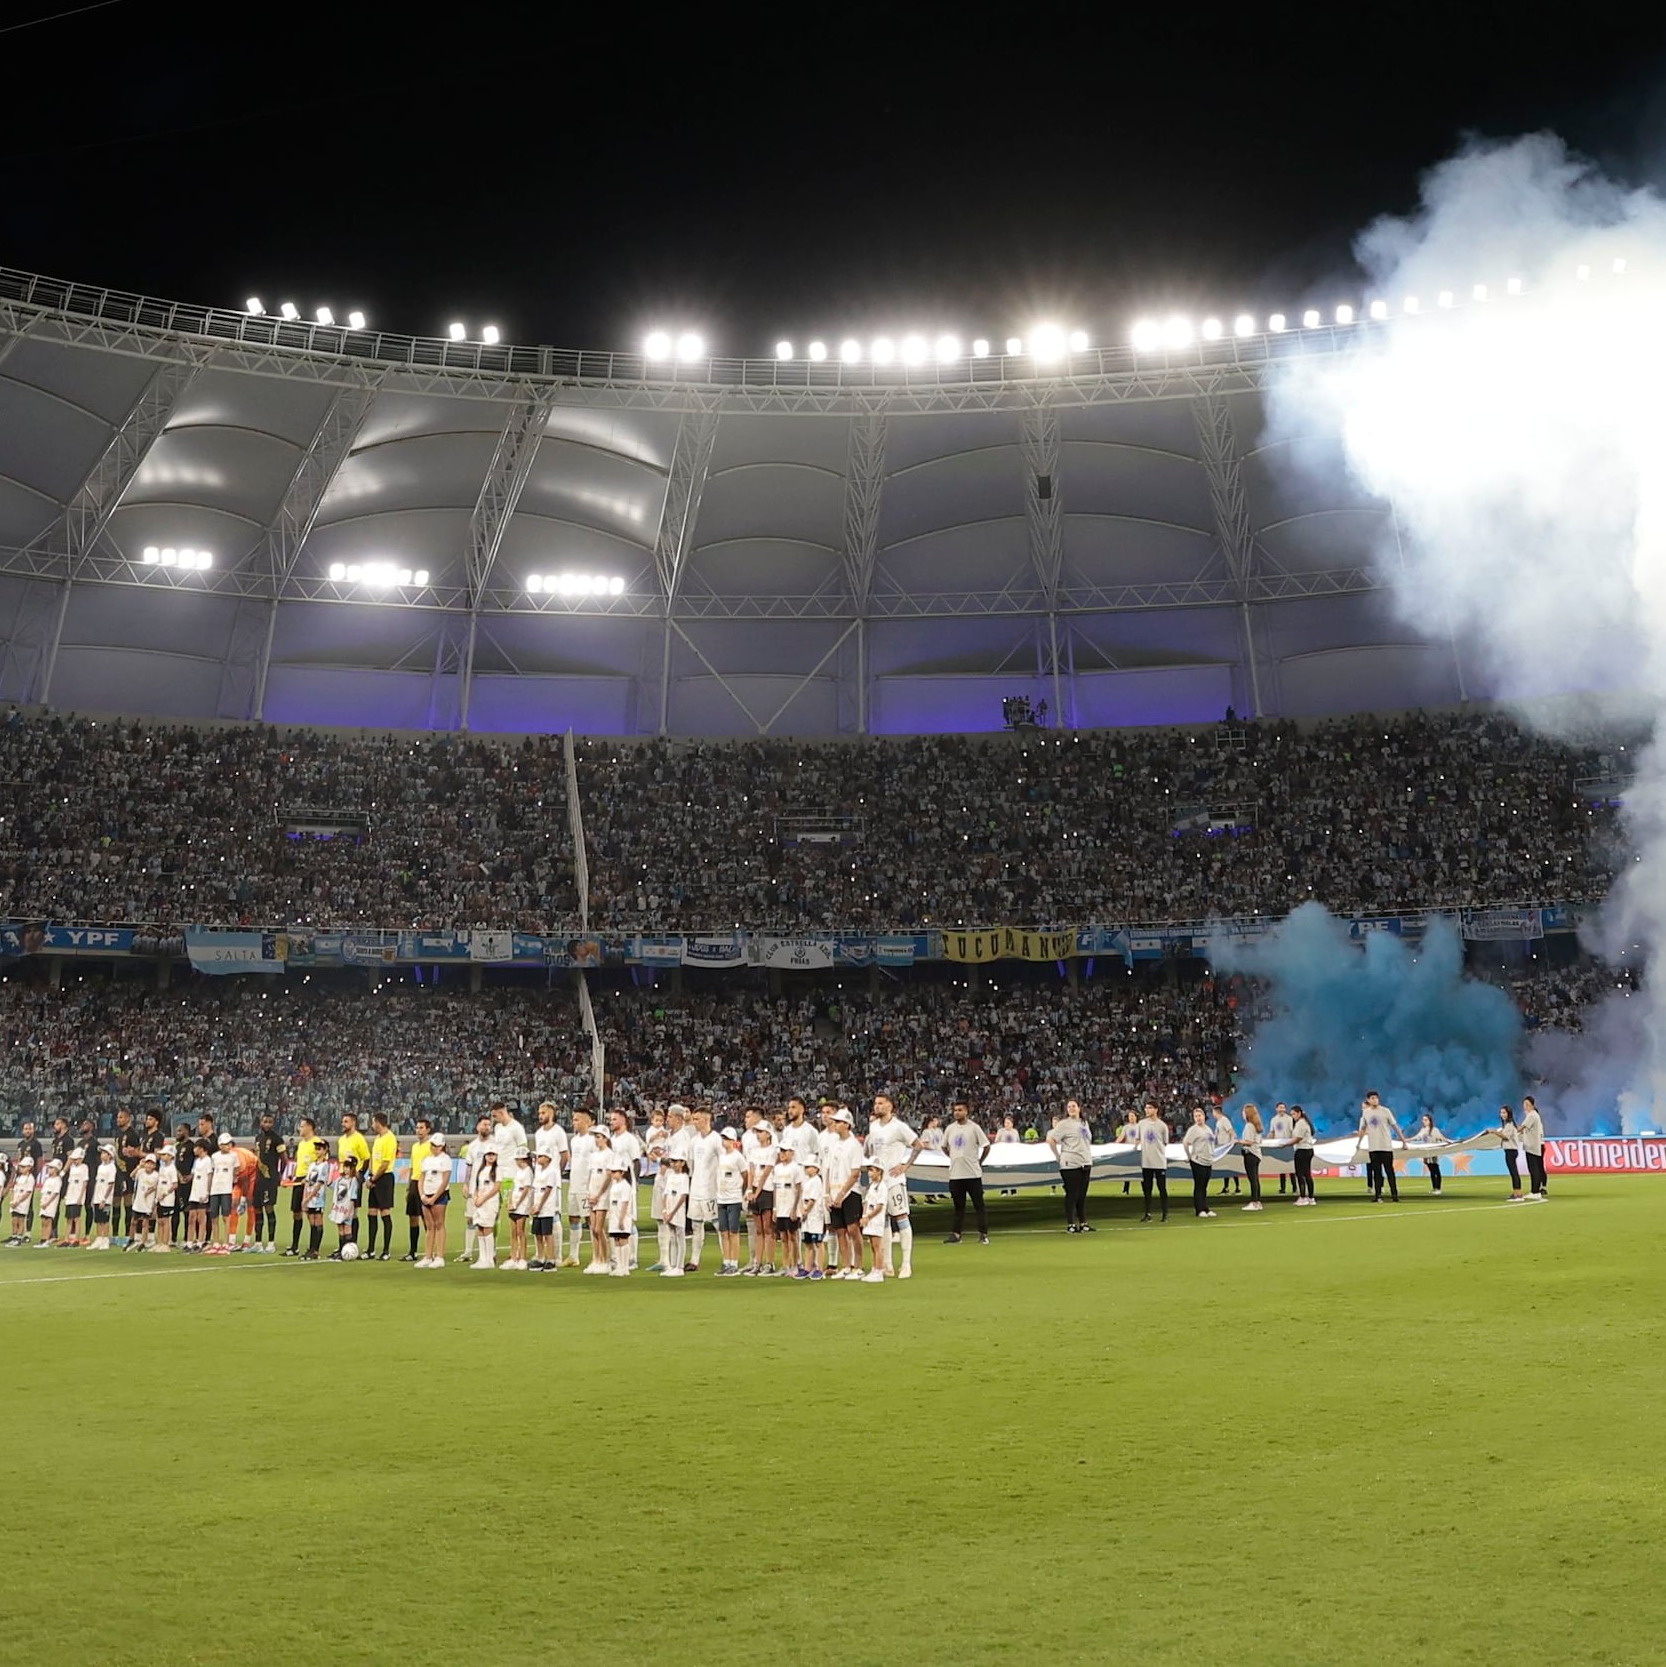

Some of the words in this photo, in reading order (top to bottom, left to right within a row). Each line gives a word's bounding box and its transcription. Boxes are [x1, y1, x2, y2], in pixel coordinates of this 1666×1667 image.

[69, 932, 120, 946] YPF
[215, 948, 256, 961] SALTA
[891, 1193, 903, 1207] 19
